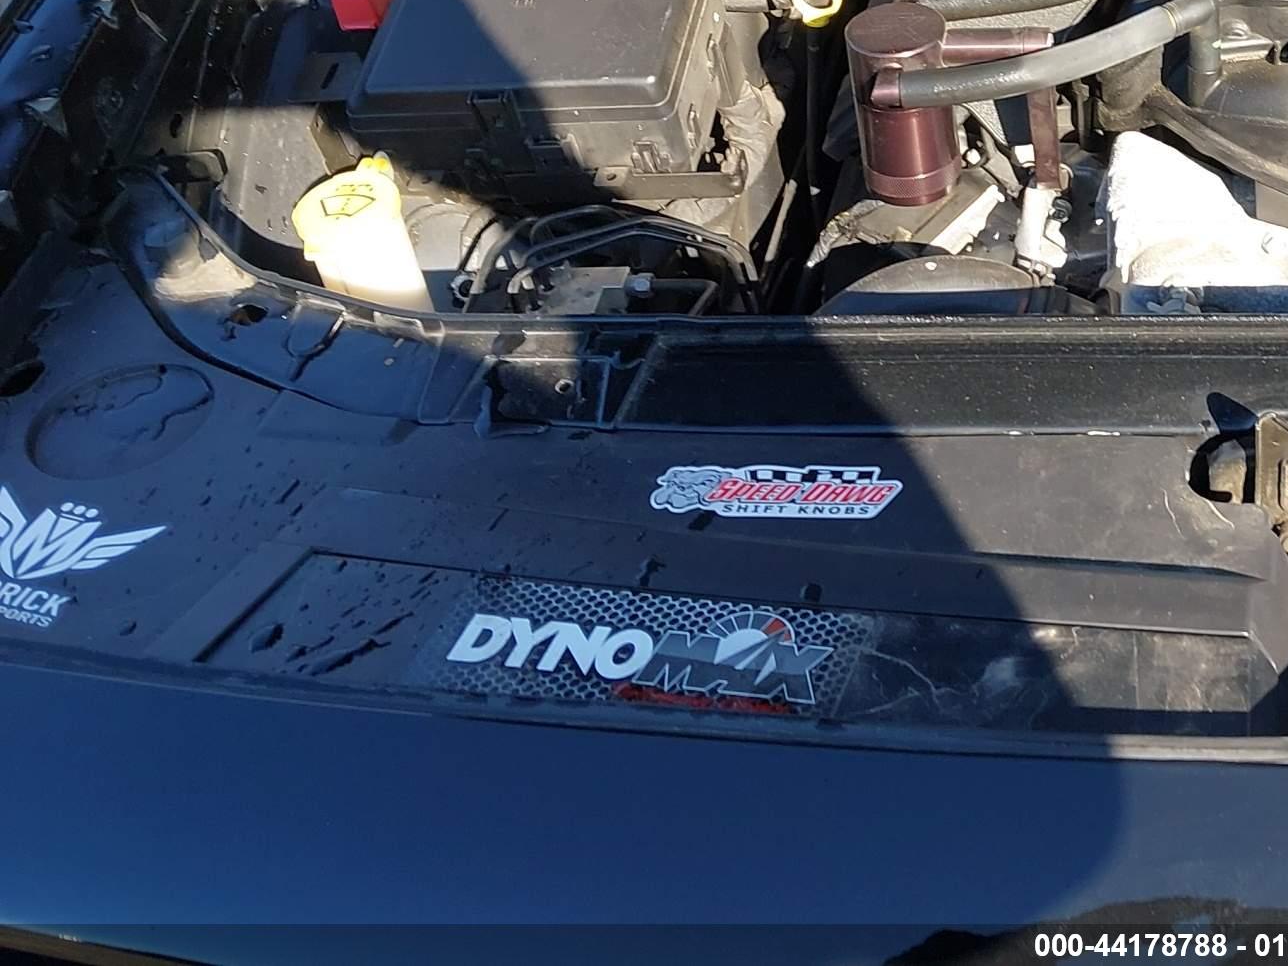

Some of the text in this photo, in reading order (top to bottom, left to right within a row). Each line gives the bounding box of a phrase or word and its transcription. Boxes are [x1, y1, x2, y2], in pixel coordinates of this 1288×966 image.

[705, 477, 898, 504] SPEED DAWG
[722, 504, 872, 515] SHIFT KNOBS
[0, 581, 71, 617] RICK
